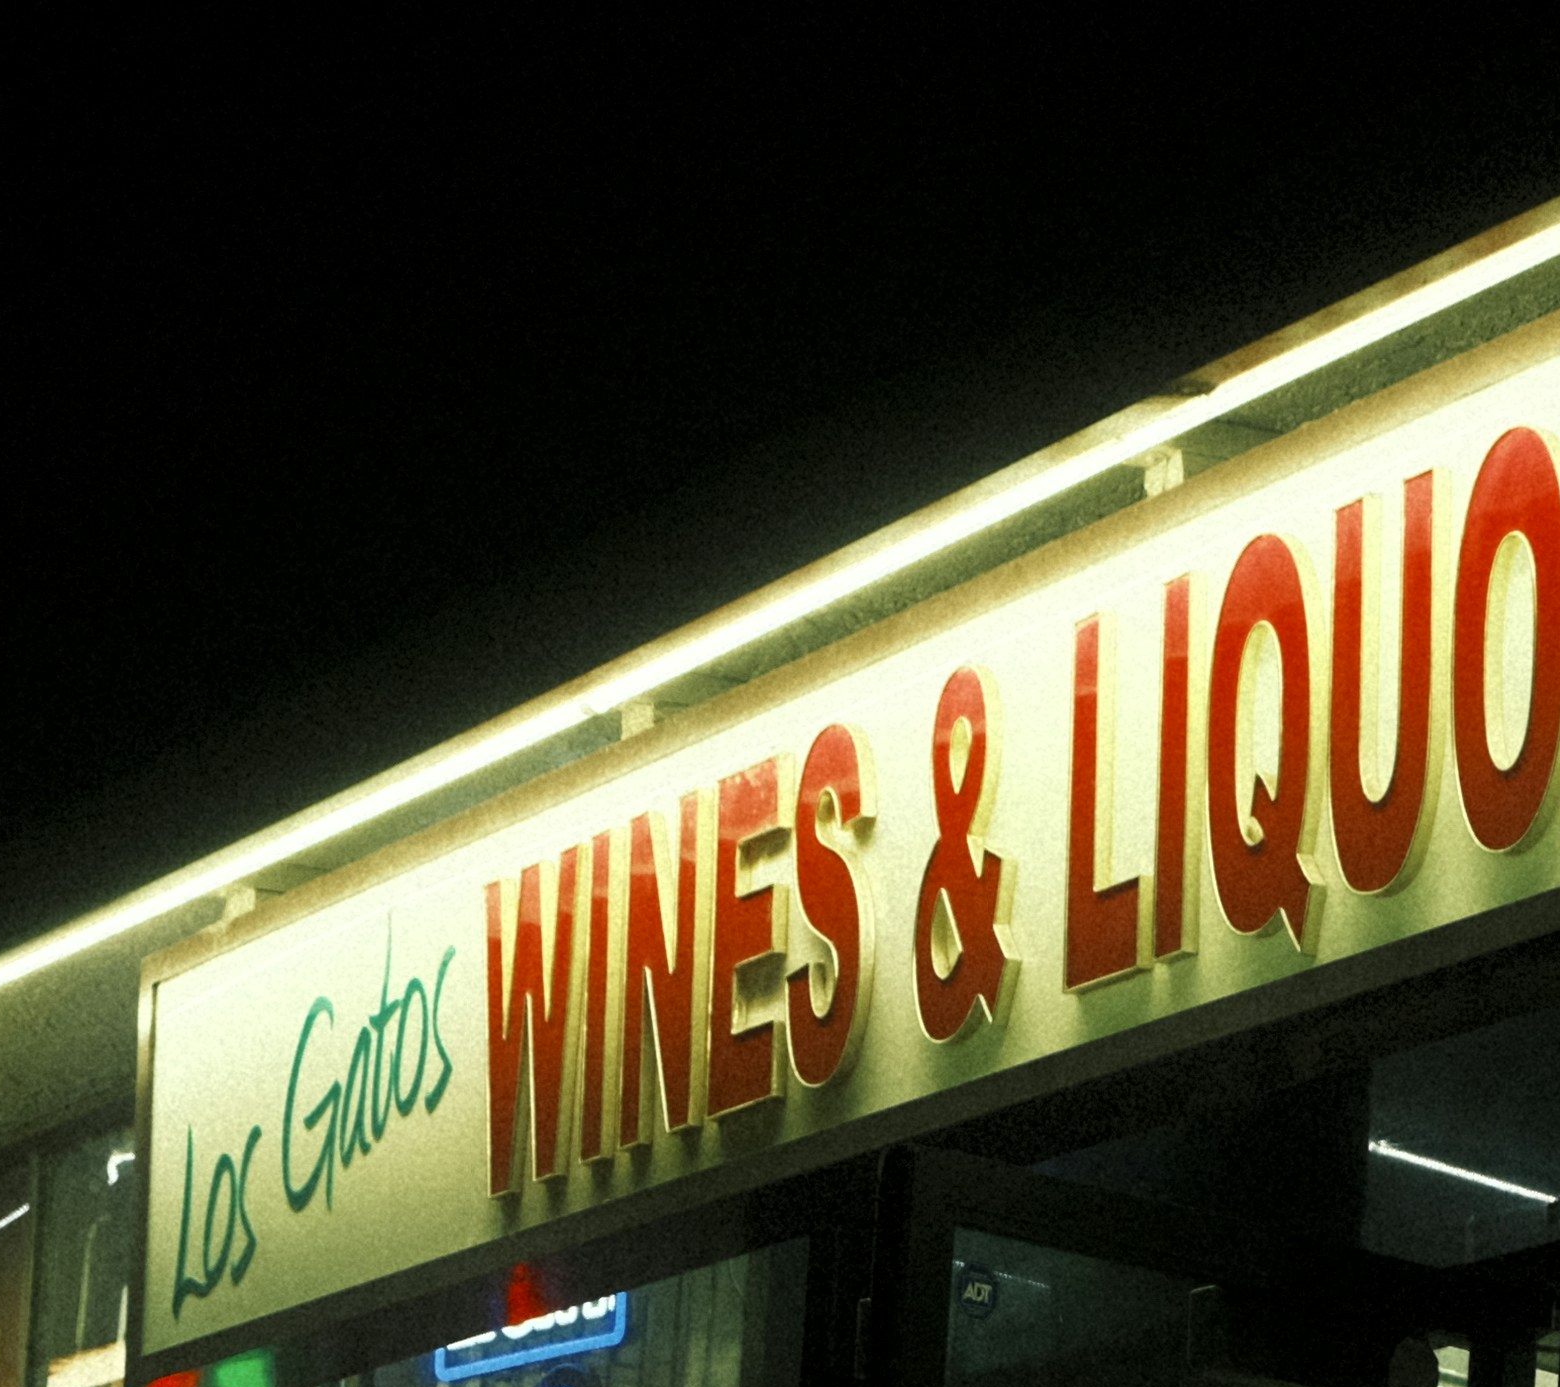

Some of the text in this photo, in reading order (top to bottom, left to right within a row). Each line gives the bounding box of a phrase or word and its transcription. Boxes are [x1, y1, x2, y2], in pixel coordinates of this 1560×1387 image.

[171, 1120, 262, 1321] Los
[282, 909, 456, 1214] Gatos
[483, 722, 877, 1199] WINES
[913, 664, 1022, 1045] &
[961, 1281, 994, 1305] ADT
